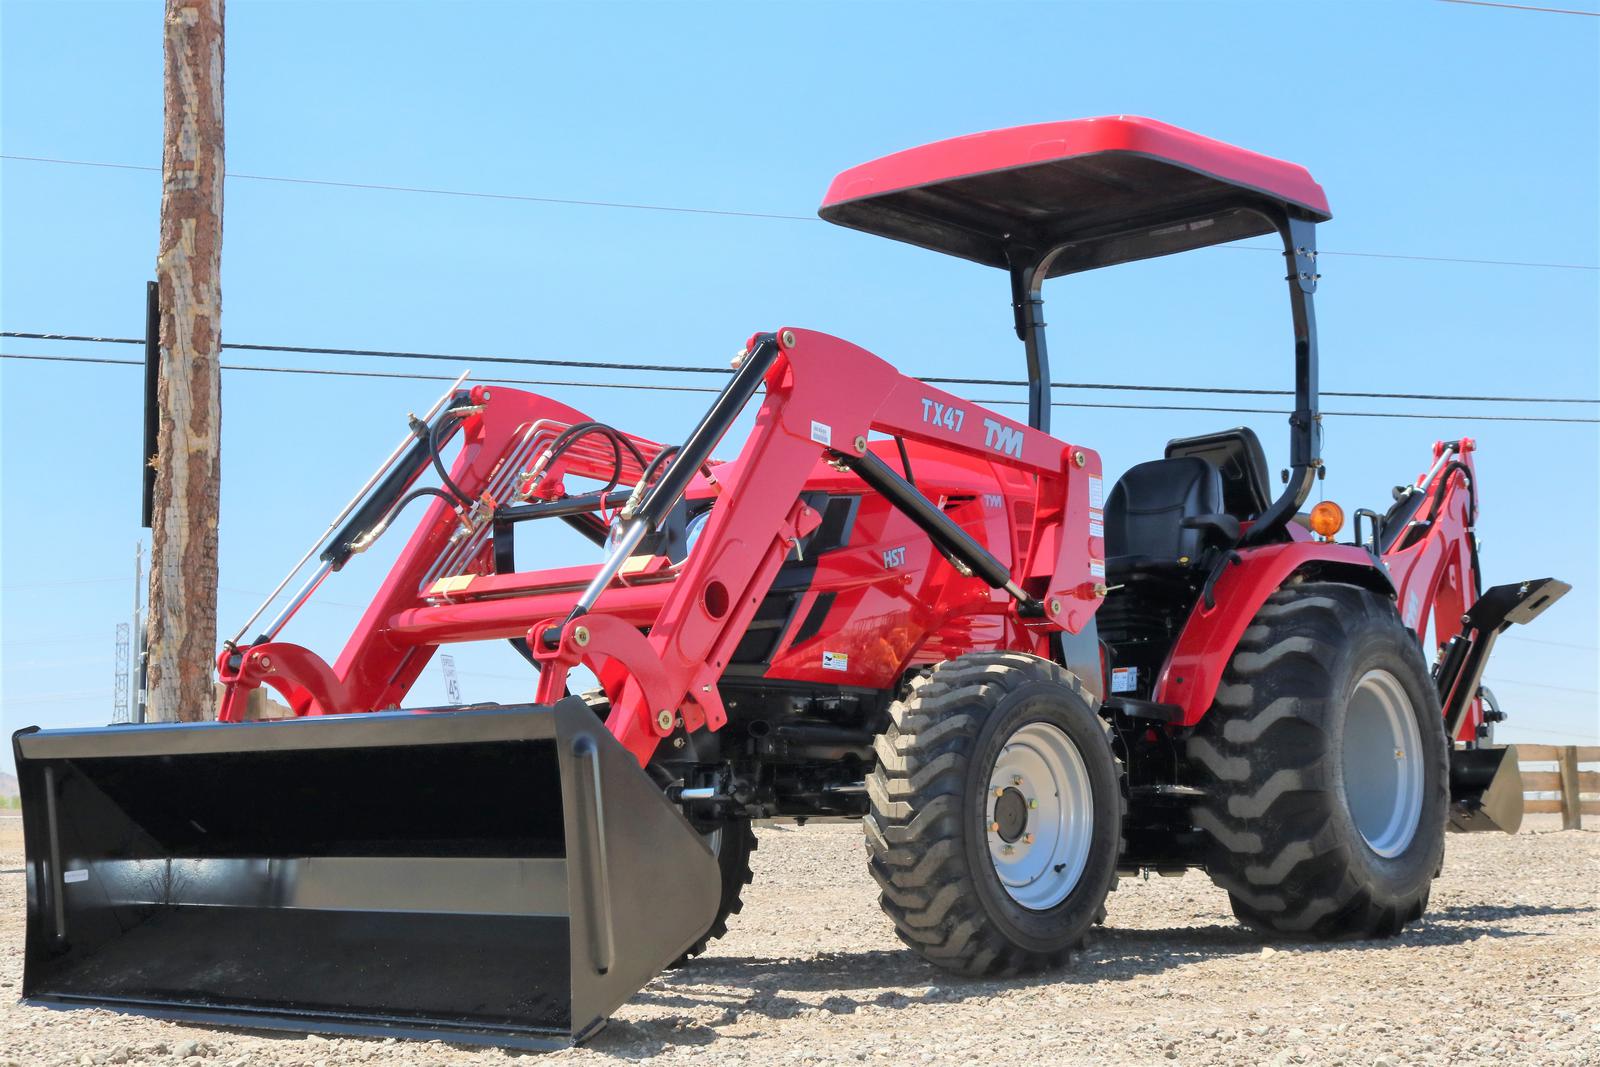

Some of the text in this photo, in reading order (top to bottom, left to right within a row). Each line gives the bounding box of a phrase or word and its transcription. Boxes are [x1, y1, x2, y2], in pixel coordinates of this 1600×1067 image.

[922, 398, 964, 432] TX47
[984, 418, 1024, 459] TYM
[883, 546, 906, 569] HST
[449, 680, 460, 700] 45
